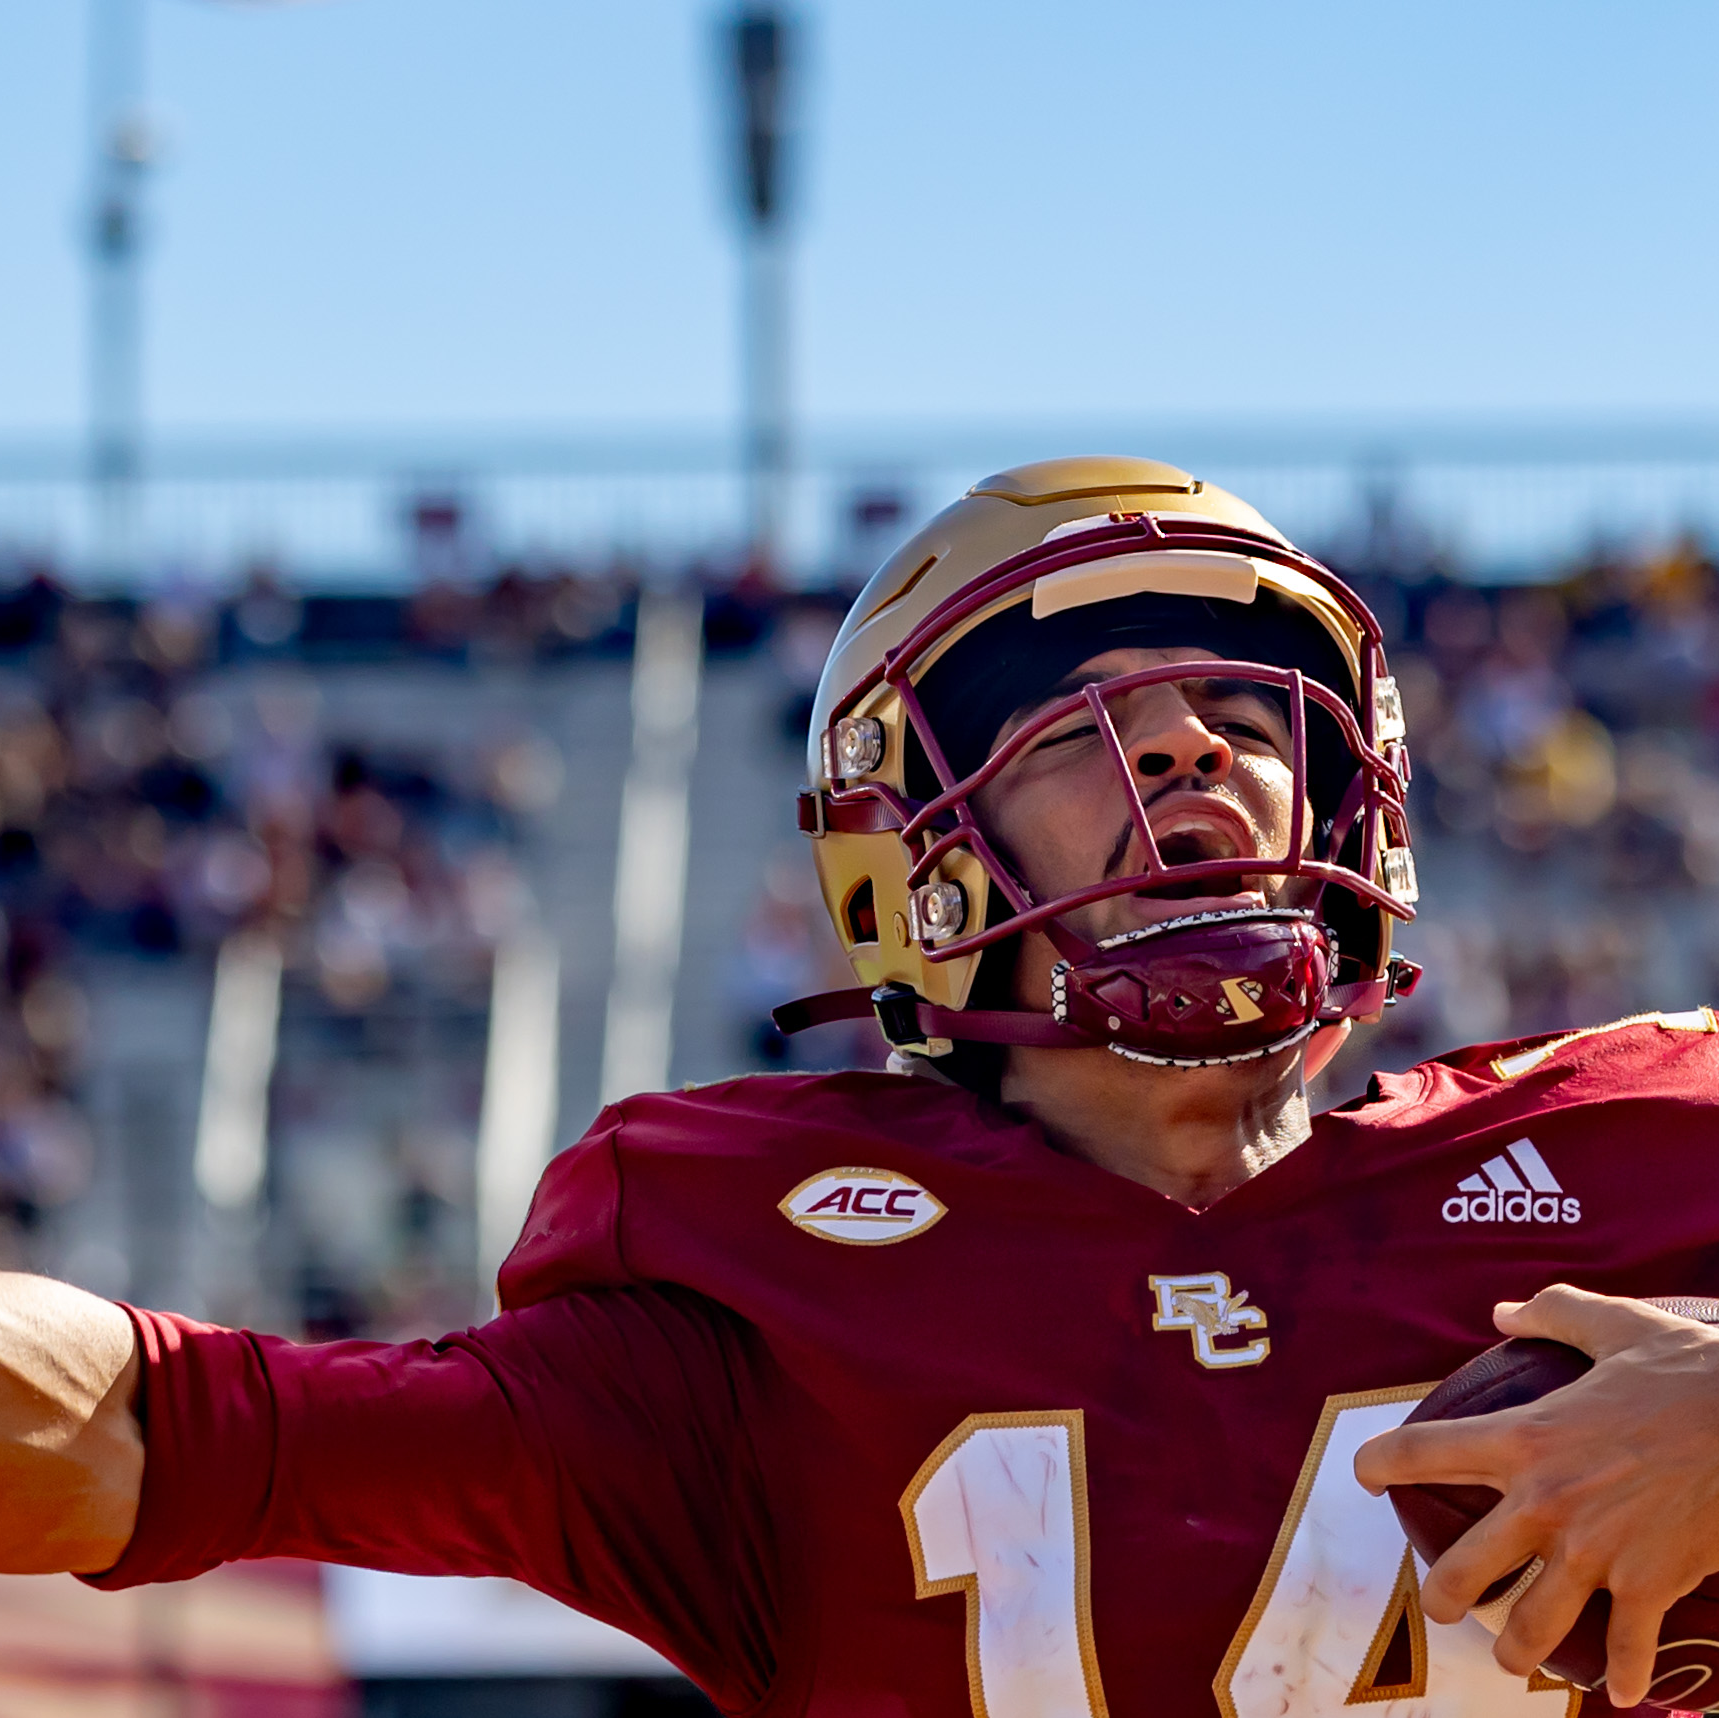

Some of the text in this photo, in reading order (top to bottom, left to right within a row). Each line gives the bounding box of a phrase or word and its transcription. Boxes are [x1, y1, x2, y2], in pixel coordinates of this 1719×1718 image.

[804, 1186, 923, 1217] ACC
[1442, 1188, 1582, 1224] adidas
[1148, 1270, 1271, 1370] BC
